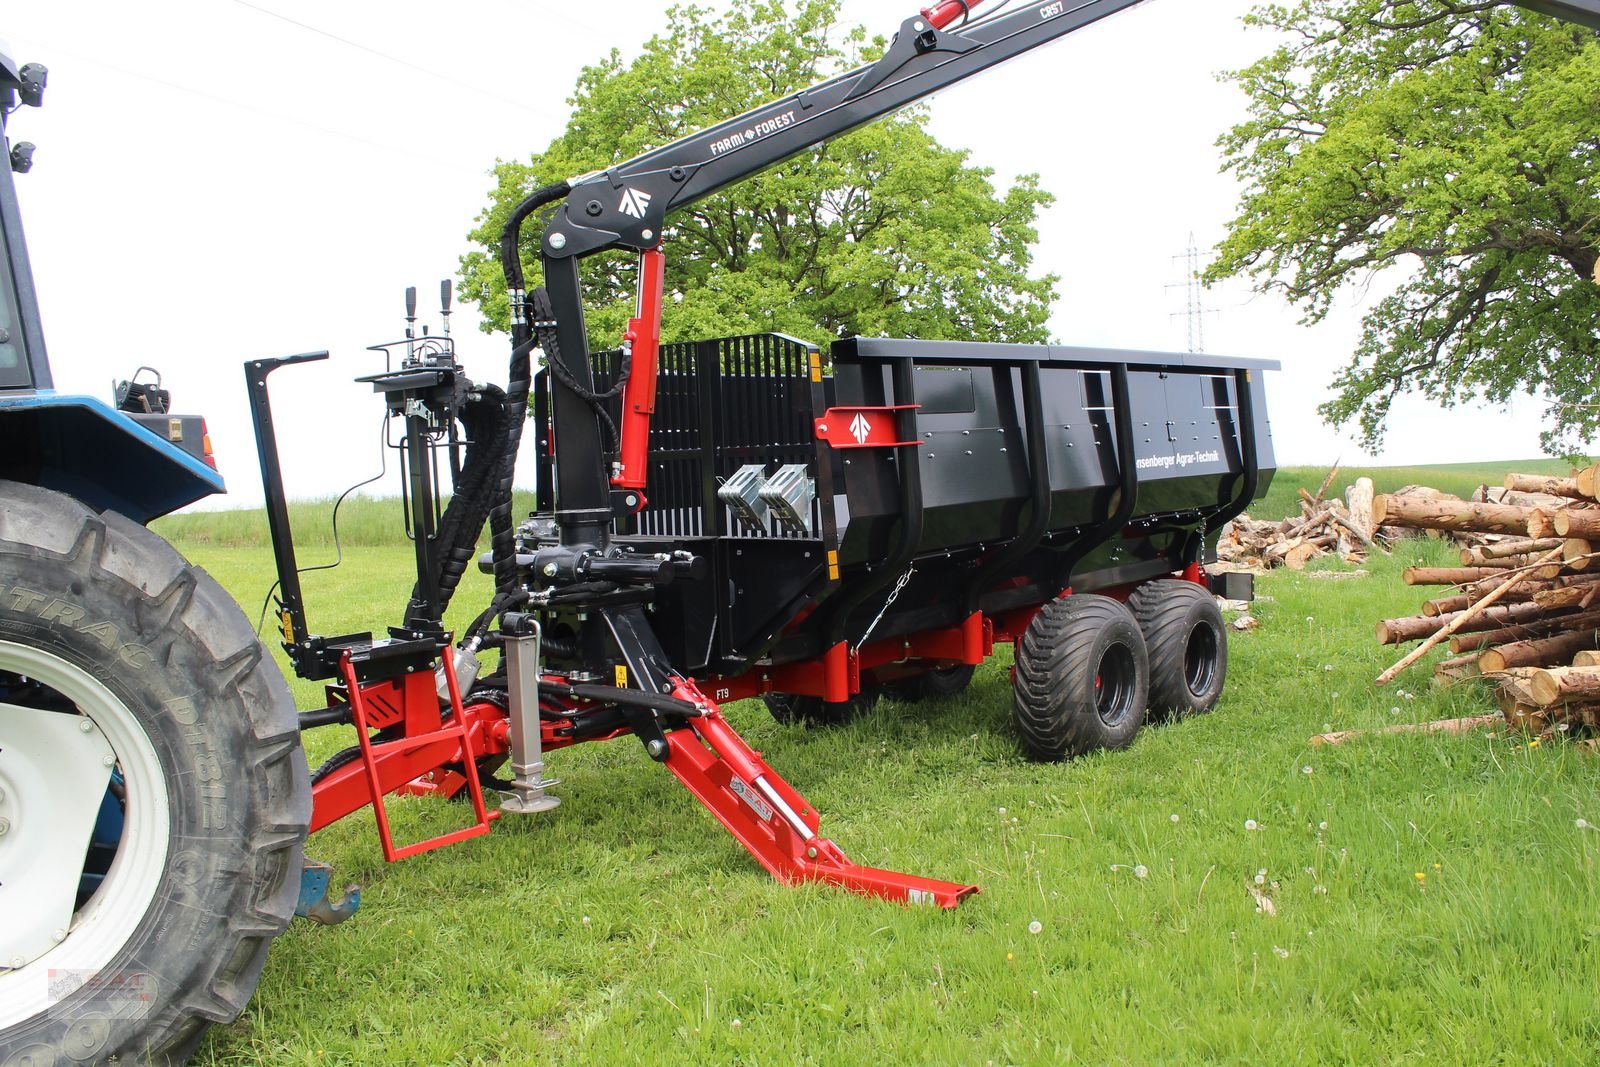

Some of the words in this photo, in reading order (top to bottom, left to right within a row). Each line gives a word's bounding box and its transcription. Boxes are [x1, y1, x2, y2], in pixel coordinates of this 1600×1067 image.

[710, 132, 745, 155] FARMI
[754, 111, 795, 136] FOREST
[1176, 450, 1219, 467] Agrar-Technik
[716, 688, 729, 700] FT9
